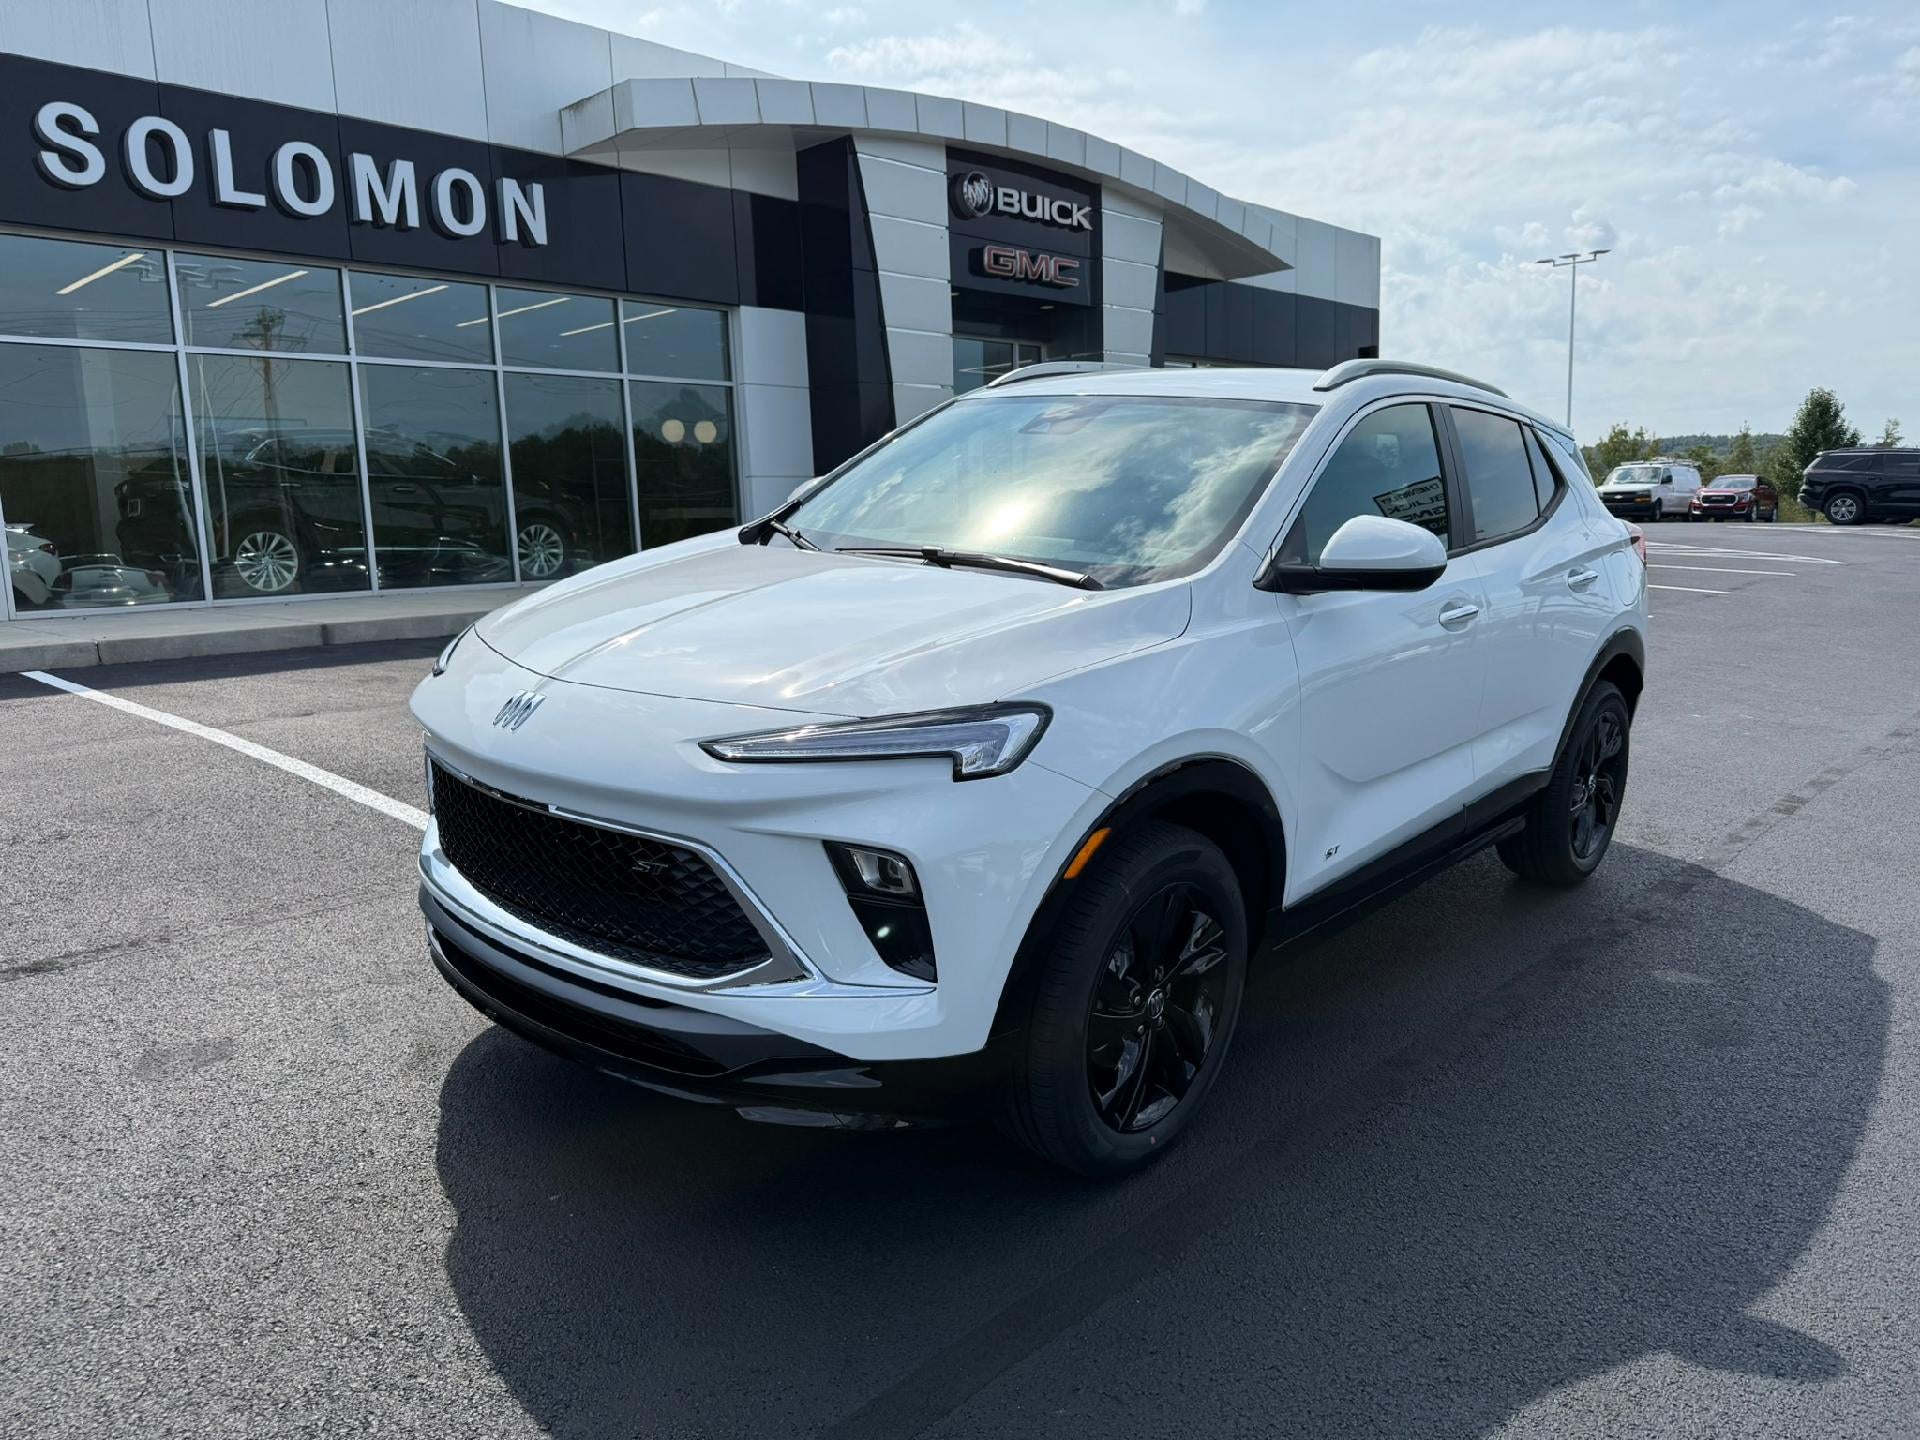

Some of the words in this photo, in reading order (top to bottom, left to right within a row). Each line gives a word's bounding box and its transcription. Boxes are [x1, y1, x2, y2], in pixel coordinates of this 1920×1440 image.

[32, 101, 548, 247] SOLOMON
[997, 186, 1093, 230] BUICK
[984, 245, 1079, 287] GMC
[632, 860, 669, 876] ST
